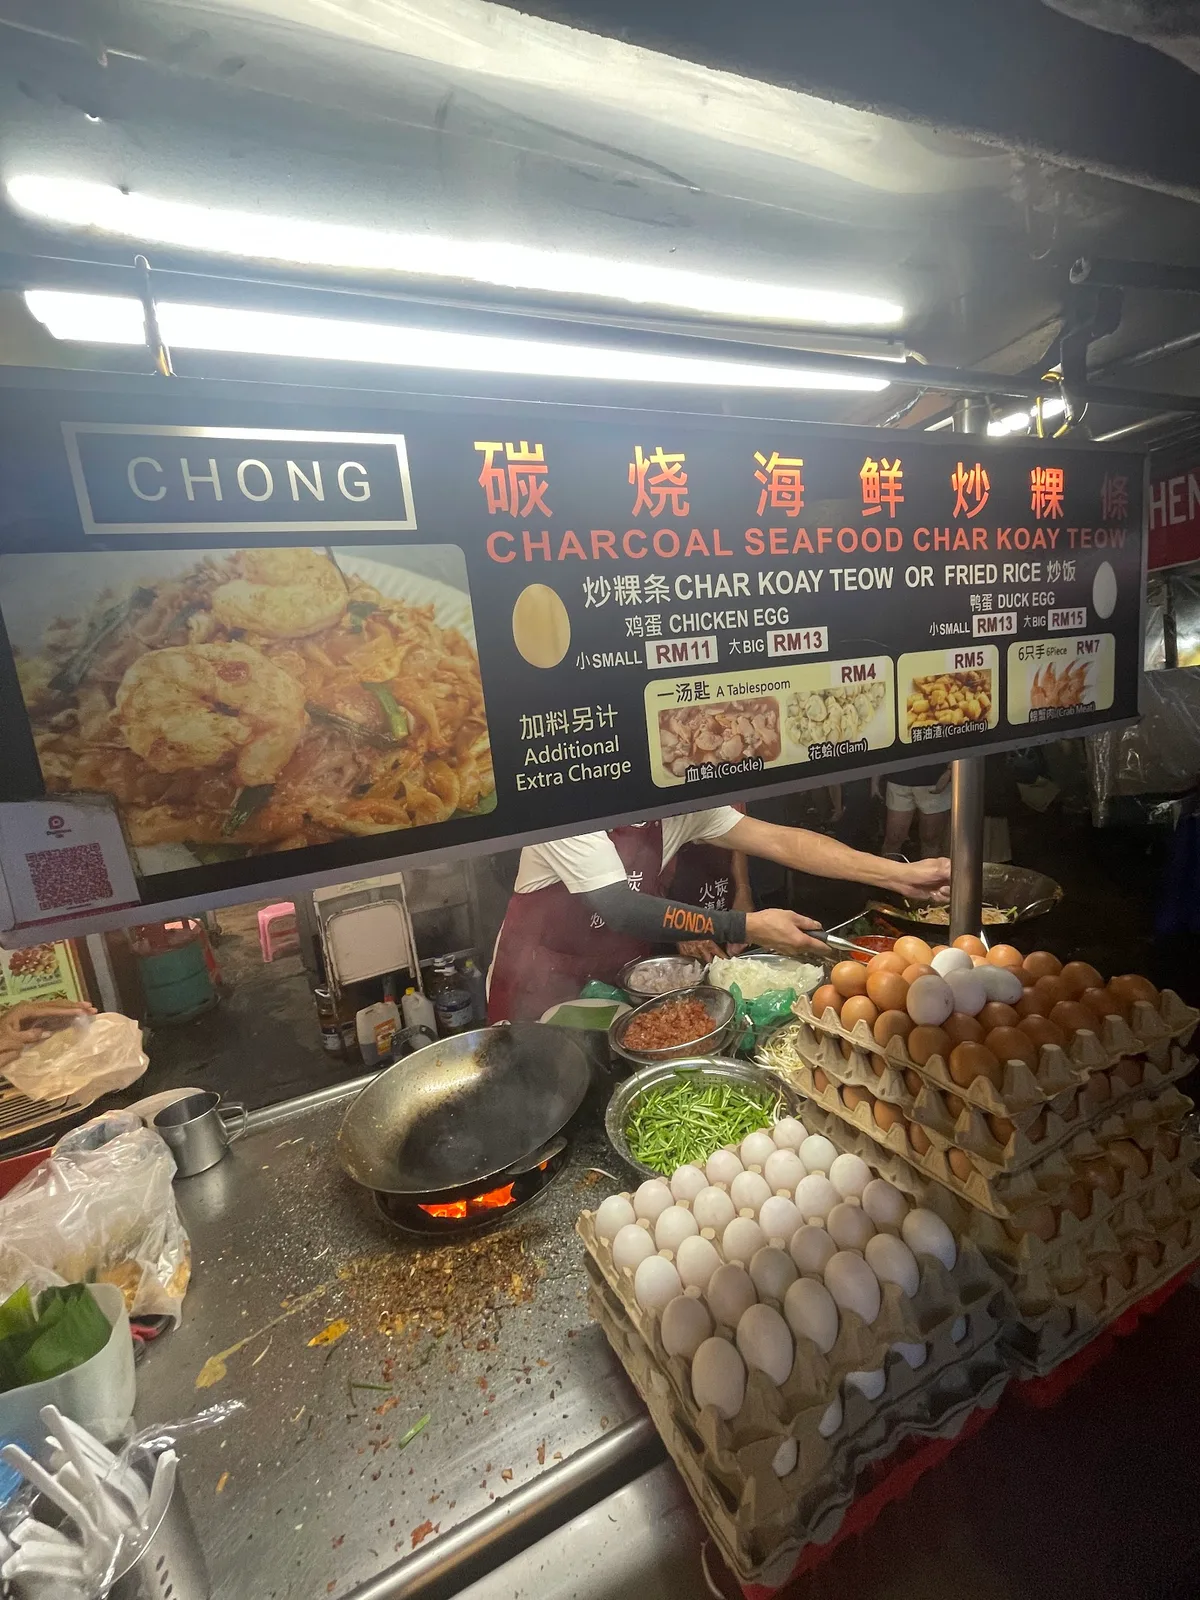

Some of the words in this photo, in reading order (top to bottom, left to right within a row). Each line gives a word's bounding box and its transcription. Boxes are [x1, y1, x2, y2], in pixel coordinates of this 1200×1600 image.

[127, 456, 372, 504] CHONG
[486, 527, 734, 564] CHARCOAL
[744, 526, 904, 557] SEAFOOD
[913, 527, 988, 552] CHAR
[997, 527, 1060, 551] KOAY
[1069, 527, 1127, 549] TEOW
[674, 572, 750, 599] CHAR
[758, 569, 824, 596] KOAY
[829, 567, 894, 592] TEOW
[905, 565, 934, 588] OR
[945, 563, 998, 586] FRIED
[1003, 562, 1041, 583] RICE
[1047, 560, 1076, 583] 炒饭
[970, 594, 992, 611] 鸭蛋
[998, 592, 1029, 609] DUCK
[1032, 591, 1055, 607] EGG
[625, 614, 663, 638] 鸡蛋
[669, 610, 749, 635] CHICKEN
[754, 607, 789, 627] EGG
[977, 615, 1013, 634] RM13
[1052, 609, 1084, 627] RM15
[656, 640, 711, 664] RM11
[774, 630, 823, 653] RM13
[954, 651, 984, 669] RM5
[1046, 646, 1067, 657] 6Piece
[1076, 640, 1100, 655] RM7
[841, 663, 877, 683] RM4
[657, 681, 711, 703] 一汤匙
[716, 687, 725, 698] A
[727, 679, 791, 696] Tablespoom
[520, 704, 619, 740] 加料另计
[524, 735, 620, 767] Additional
[516, 769, 563, 792] Extra
[568, 757, 632, 783] Charge
[663, 905, 715, 935] HONDA
